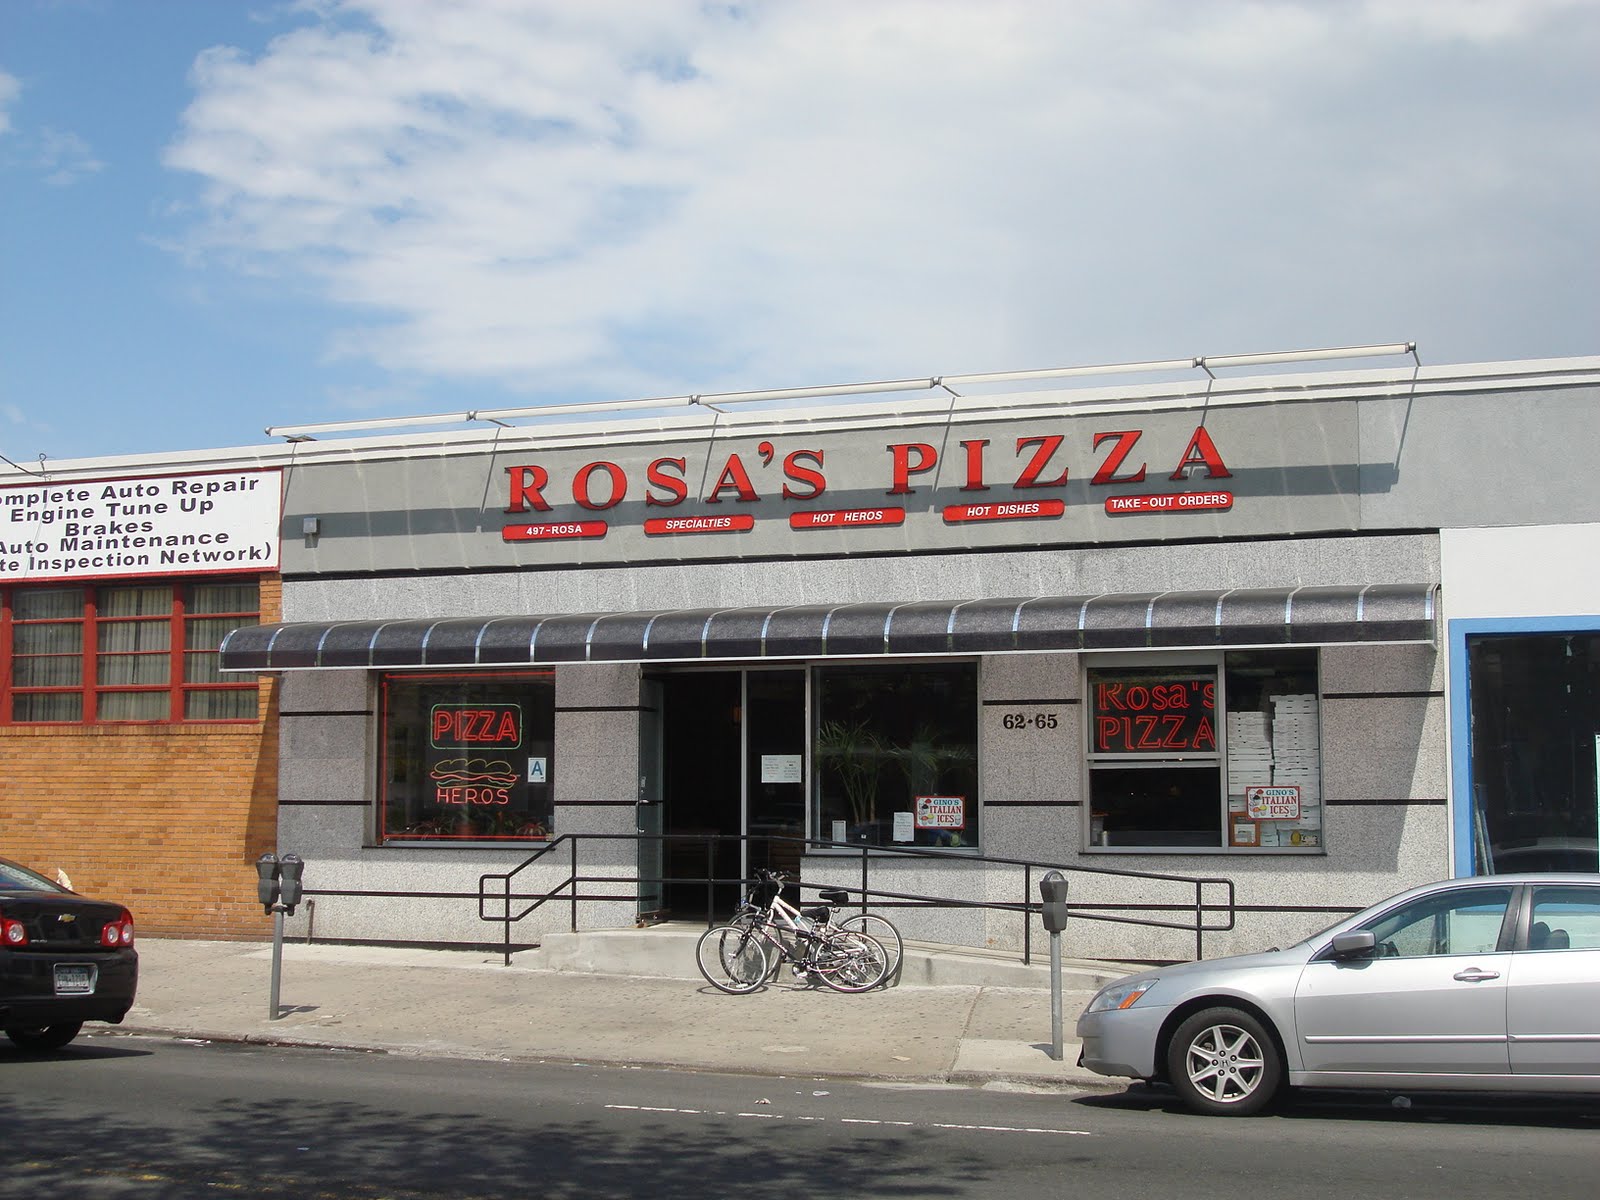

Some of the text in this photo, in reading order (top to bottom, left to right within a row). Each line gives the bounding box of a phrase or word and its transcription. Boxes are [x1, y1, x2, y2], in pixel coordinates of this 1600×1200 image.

[503, 425, 1234, 513] ROSA'S PIZZA
[0, 477, 259, 508] mplete Auto Repair
[1111, 493, 1228, 509] TAKE-OUT ORDERS
[11, 498, 214, 524] Engine Tune Up
[812, 509, 883, 523] HOT HEROS
[967, 503, 1040, 518] HOT DISHES
[65, 521, 154, 537] Brakes
[526, 524, 583, 536] 497-ROSA
[665, 517, 731, 530] SPECIALTIES
[60, 532, 230, 552] Maintenance
[29, 552, 149, 572] Inspection
[160, 542, 272, 565] Network)
[433, 711, 517, 741] PIZZA
[1096, 715, 1216, 749] PIZZA
[531, 760, 543, 776] A
[436, 788, 509, 805] HEROS
[1262, 796, 1297, 805] ITALIAN
[929, 805, 962, 814] ITALIAN
[1270, 805, 1290, 815] ICES
[937, 814, 955, 823] ICES
